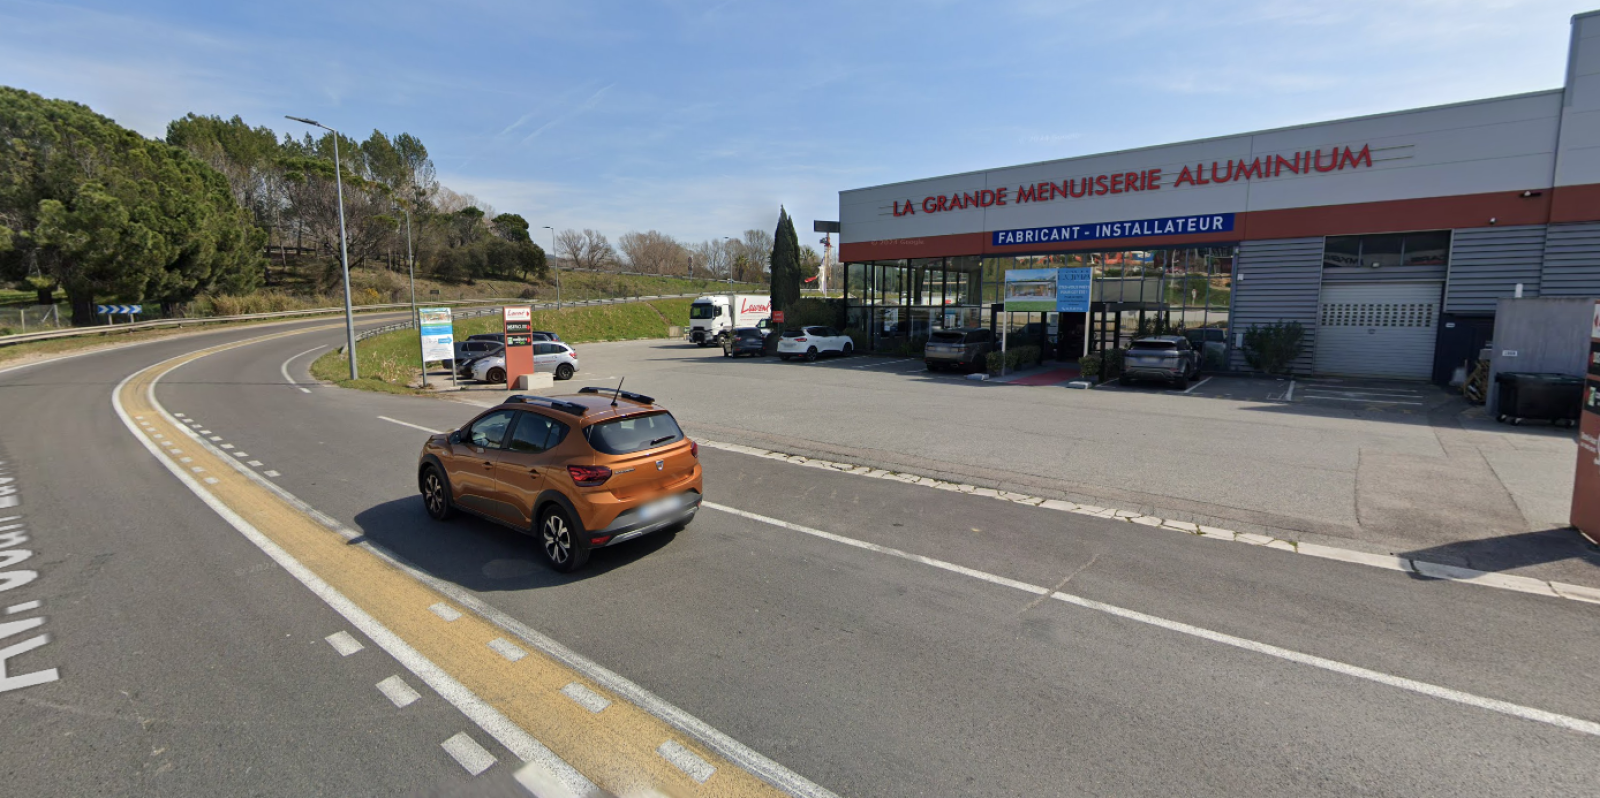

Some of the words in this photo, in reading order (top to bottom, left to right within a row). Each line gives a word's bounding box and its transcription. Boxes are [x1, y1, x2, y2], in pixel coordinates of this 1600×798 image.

[893, 200, 914, 217] LA
[922, 187, 1007, 214] GRANDE
[1016, 168, 1162, 204] MENUISERIE
[1173, 143, 1373, 188] ALUMINIUM
[998, 226, 1080, 244] FABRICANT
[1095, 215, 1224, 238] INSTALLATEUR
